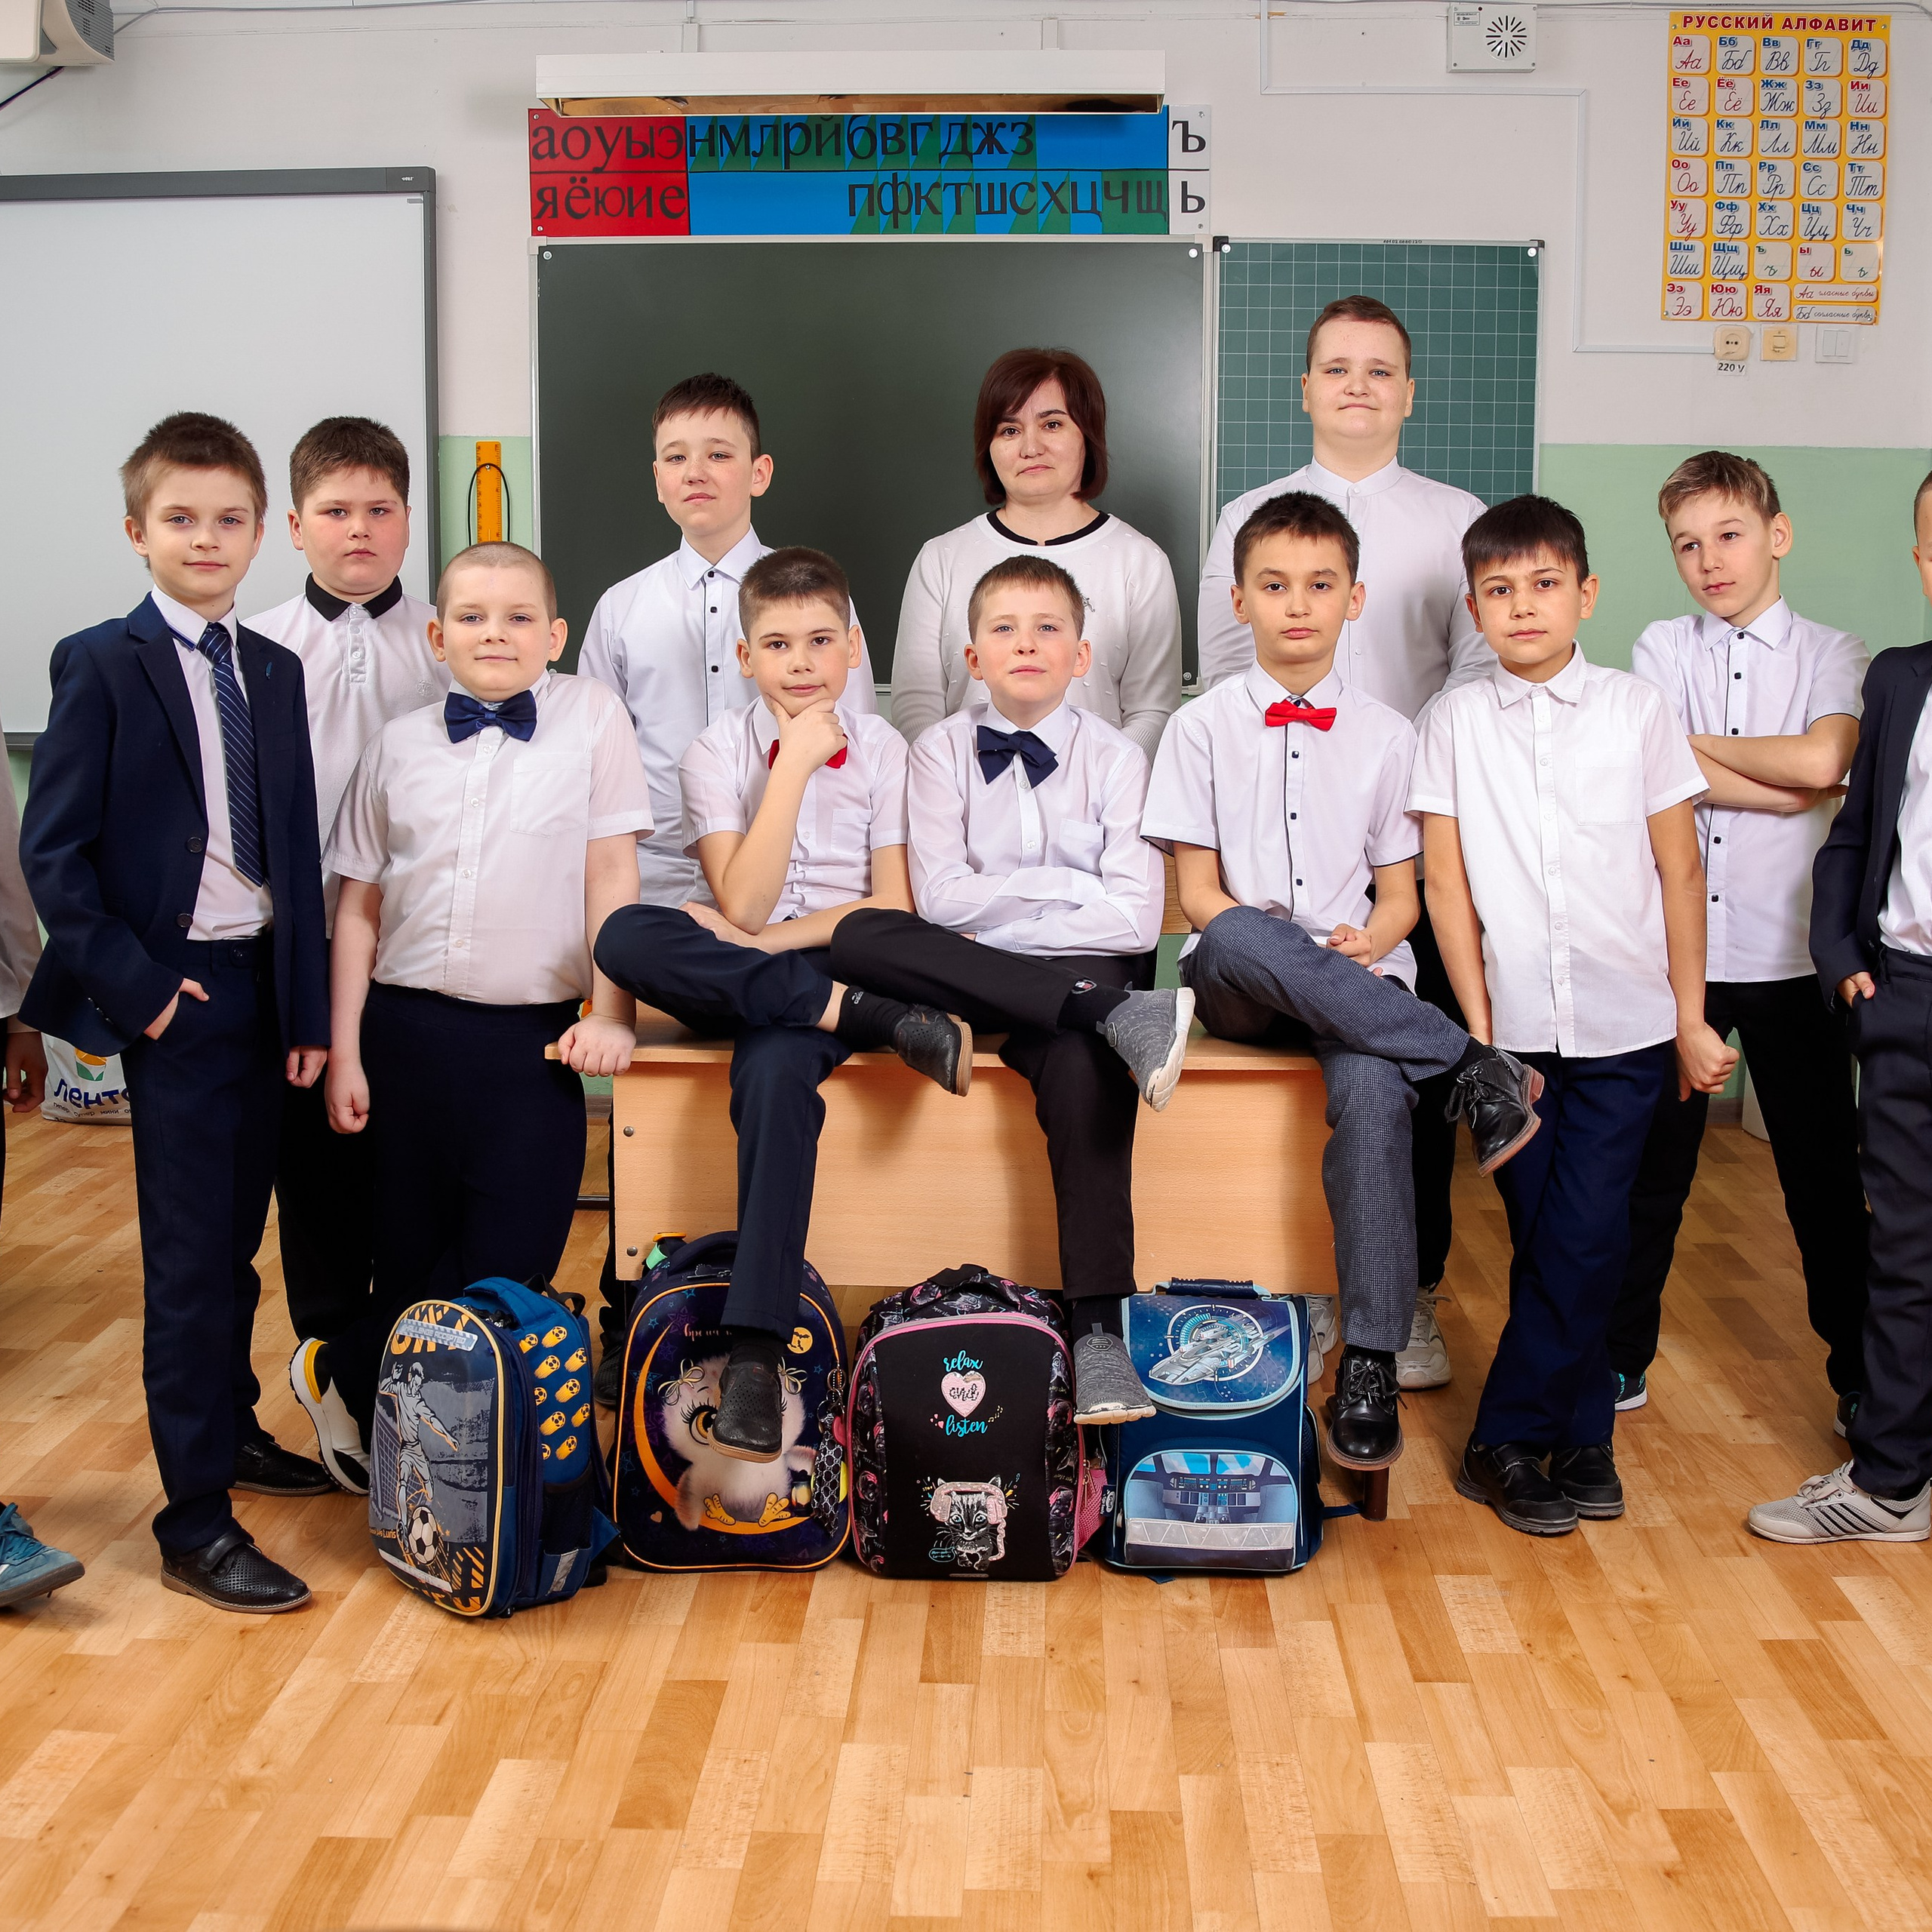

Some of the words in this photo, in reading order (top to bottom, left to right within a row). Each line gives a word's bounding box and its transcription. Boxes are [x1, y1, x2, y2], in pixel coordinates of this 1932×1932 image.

[1683, 14, 1773, 29] РУССКИЙ
[1782, 17, 1876, 31] АЛФАВИТ
[1673, 37, 1690, 46] Аа
[1719, 37, 1736, 46] Бб
[1763, 38, 1780, 47] Вв
[1807, 39, 1820, 48] Гг
[1850, 40, 1869, 50] Дд
[1672, 78, 1688, 87] Ее
[1718, 77, 1734, 88] Ёё
[1761, 80, 1785, 88] Жж
[1805, 81, 1822, 90] Зз
[1850, 82, 1869, 90] Ии
[1673, 117, 1689, 128] Йй
[1717, 120, 1732, 128] Кк
[1760, 121, 1778, 129] Лл
[1805, 122, 1826, 130] Мм
[1850, 122, 1868, 131] Нн
[1672, 159, 1688, 168] Оо
[1759, 162, 1775, 173] Рр
[1803, 163, 1820, 171] Сс
[1848, 164, 1863, 172] Тт
[1671, 200, 1685, 211] Уу
[1715, 202, 1738, 212] Фф
[1758, 202, 1774, 211] Хх
[1802, 204, 1820, 214] Цц
[1847, 205, 1864, 213] Чч
[1667, 284, 1684, 292] Ээ
[1711, 285, 1736, 293] Юю
[1755, 285, 1770, 294] Яя
[1796, 285, 1814, 299] Аа
[1852, 288, 1874, 300] буквы
[1718, 363, 1736, 371] 220
[1738, 364, 1745, 372] V
[943, 1350, 983, 1371] relax
[946, 1415, 988, 1437] listen
